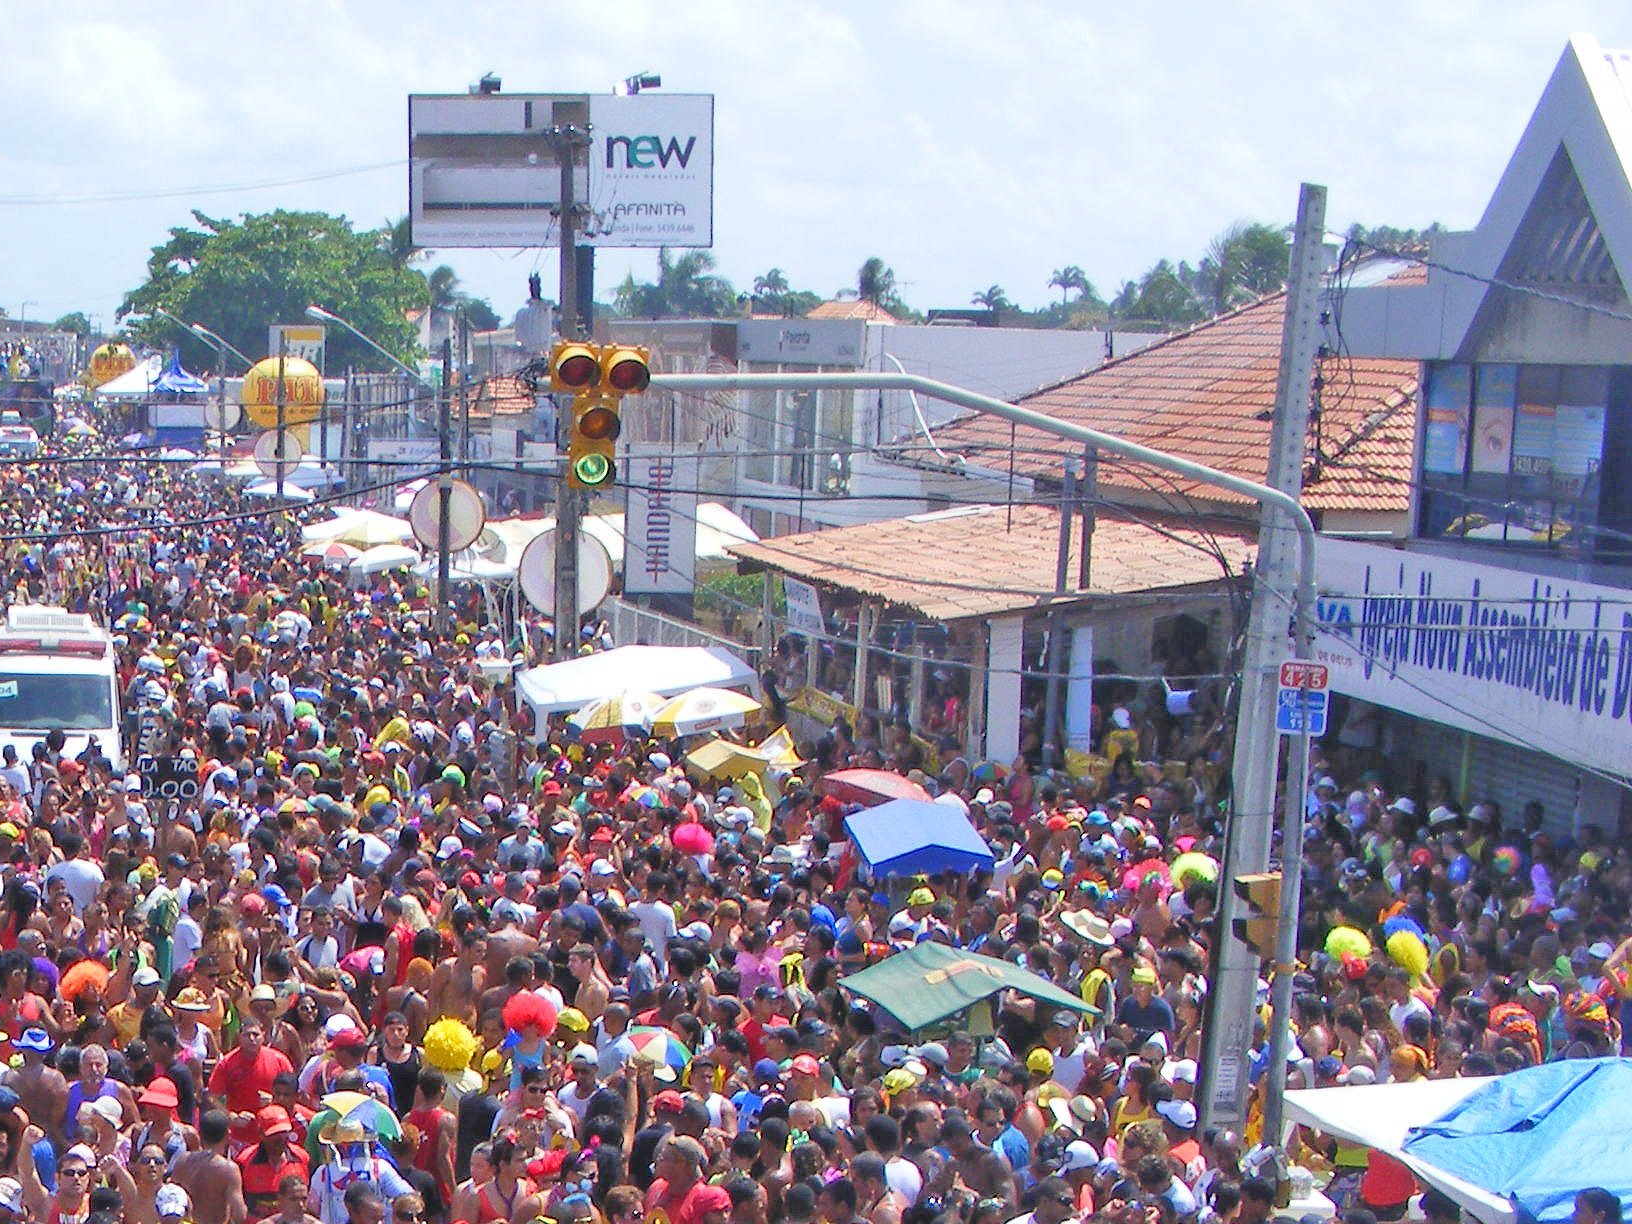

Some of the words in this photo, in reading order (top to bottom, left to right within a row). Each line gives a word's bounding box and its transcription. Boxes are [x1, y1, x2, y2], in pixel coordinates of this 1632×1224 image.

[606, 135, 697, 169] new
[1359, 562, 1413, 681] Igreja
[1414, 571, 1463, 673] Nova
[1579, 597, 1610, 716] de
